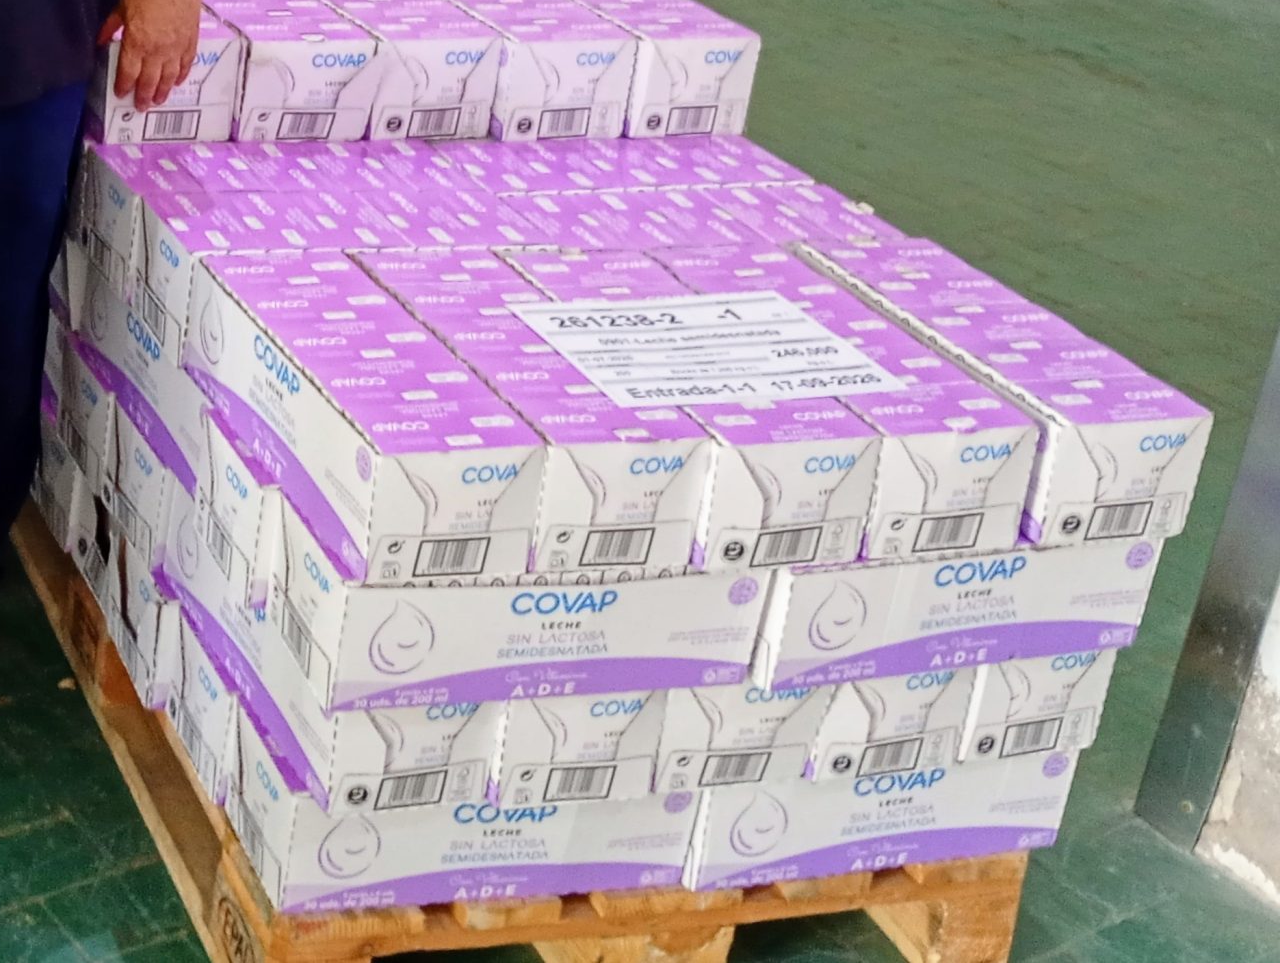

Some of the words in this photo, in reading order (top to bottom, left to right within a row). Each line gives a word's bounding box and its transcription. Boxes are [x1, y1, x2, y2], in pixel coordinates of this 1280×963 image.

[312, 53, 367, 68] COVAP
[549, 312, 684, 329] 261238-2
[127, 311, 160, 362] COVAP
[254, 334, 300, 396] COVAP
[626, 382, 756, 399] Entrada-1-1
[934, 556, 1027, 588] COVAP
[511, 590, 618, 615] COVAP
[541, 621, 582, 630] LECHE
[506, 634, 531, 645] SIN
[538, 630, 606, 644] LACTOSA
[496, 644, 608, 659] SEMIDESNATADA
[854, 769, 947, 796] COVAP
[454, 804, 558, 824] COVAP
